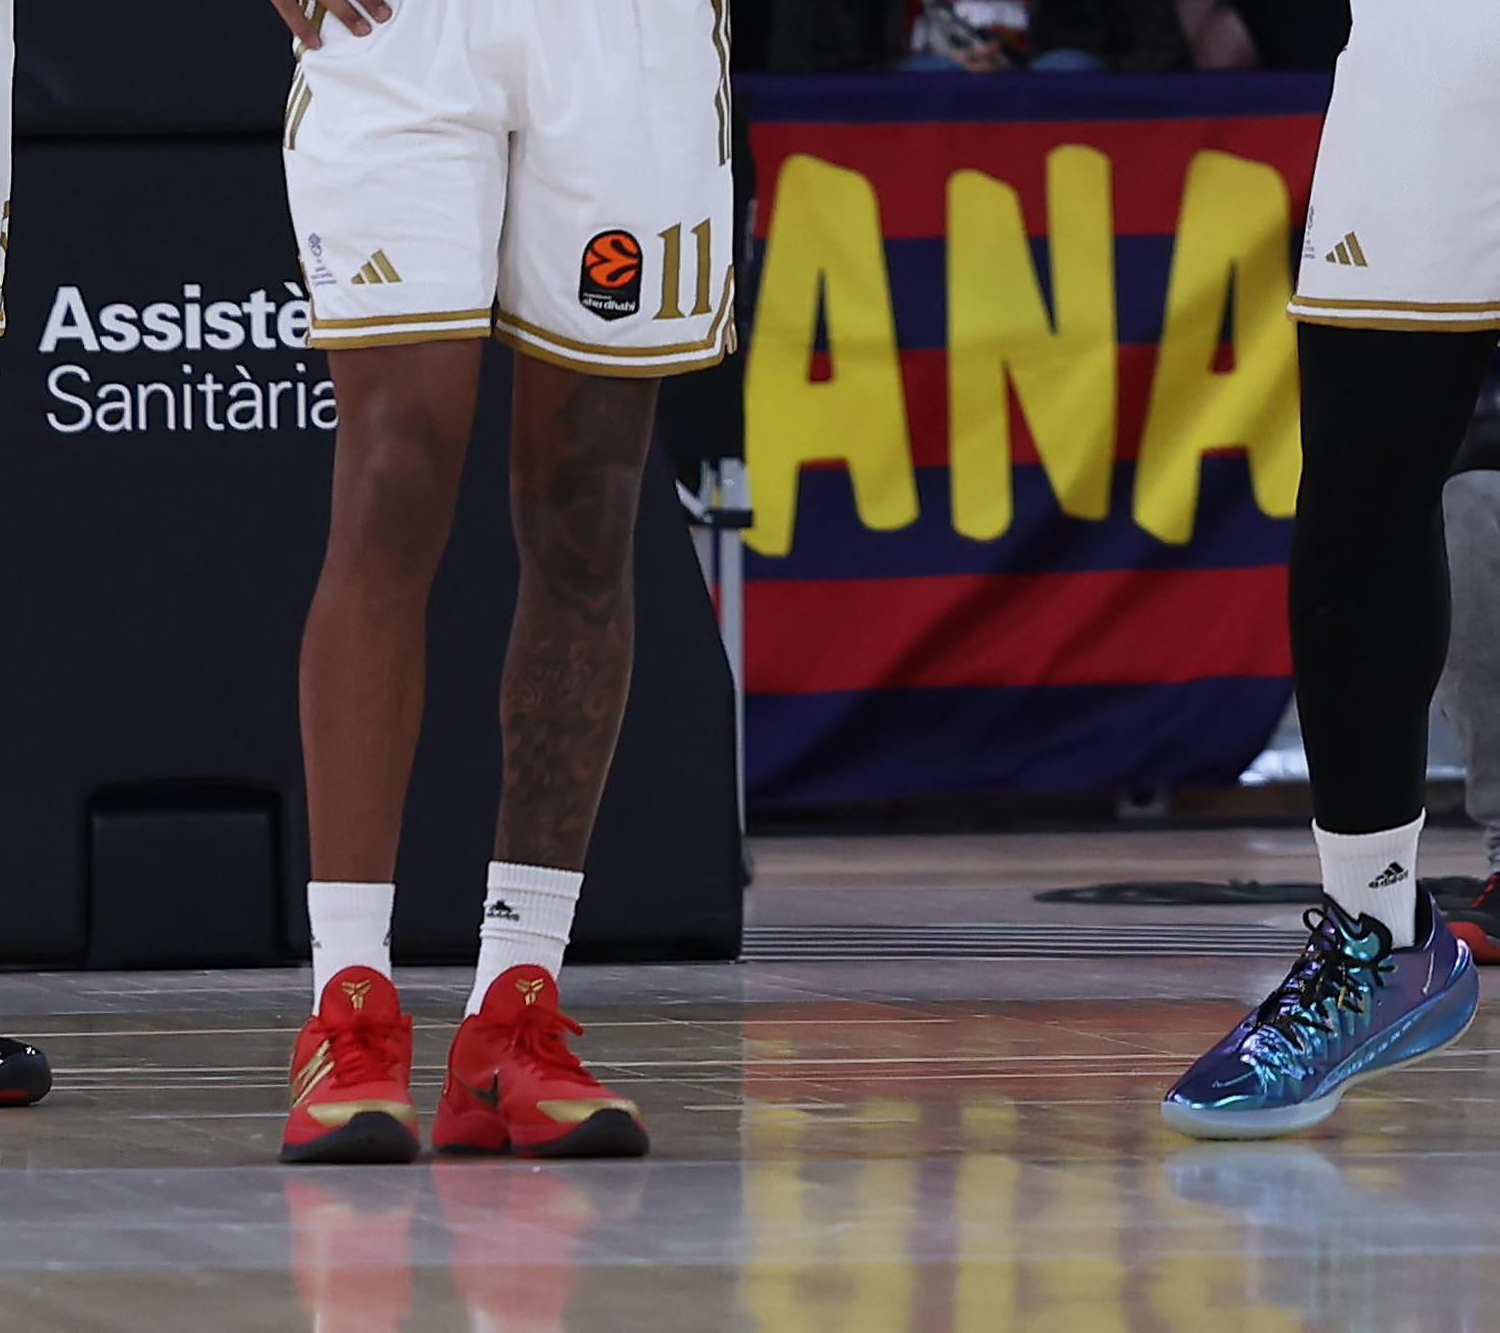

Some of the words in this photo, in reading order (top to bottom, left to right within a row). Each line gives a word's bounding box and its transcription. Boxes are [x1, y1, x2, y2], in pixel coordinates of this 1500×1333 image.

[652, 218, 713, 320] 11
[46, 363, 339, 432] Sanitària
[741, 144, 1303, 557] ANA
